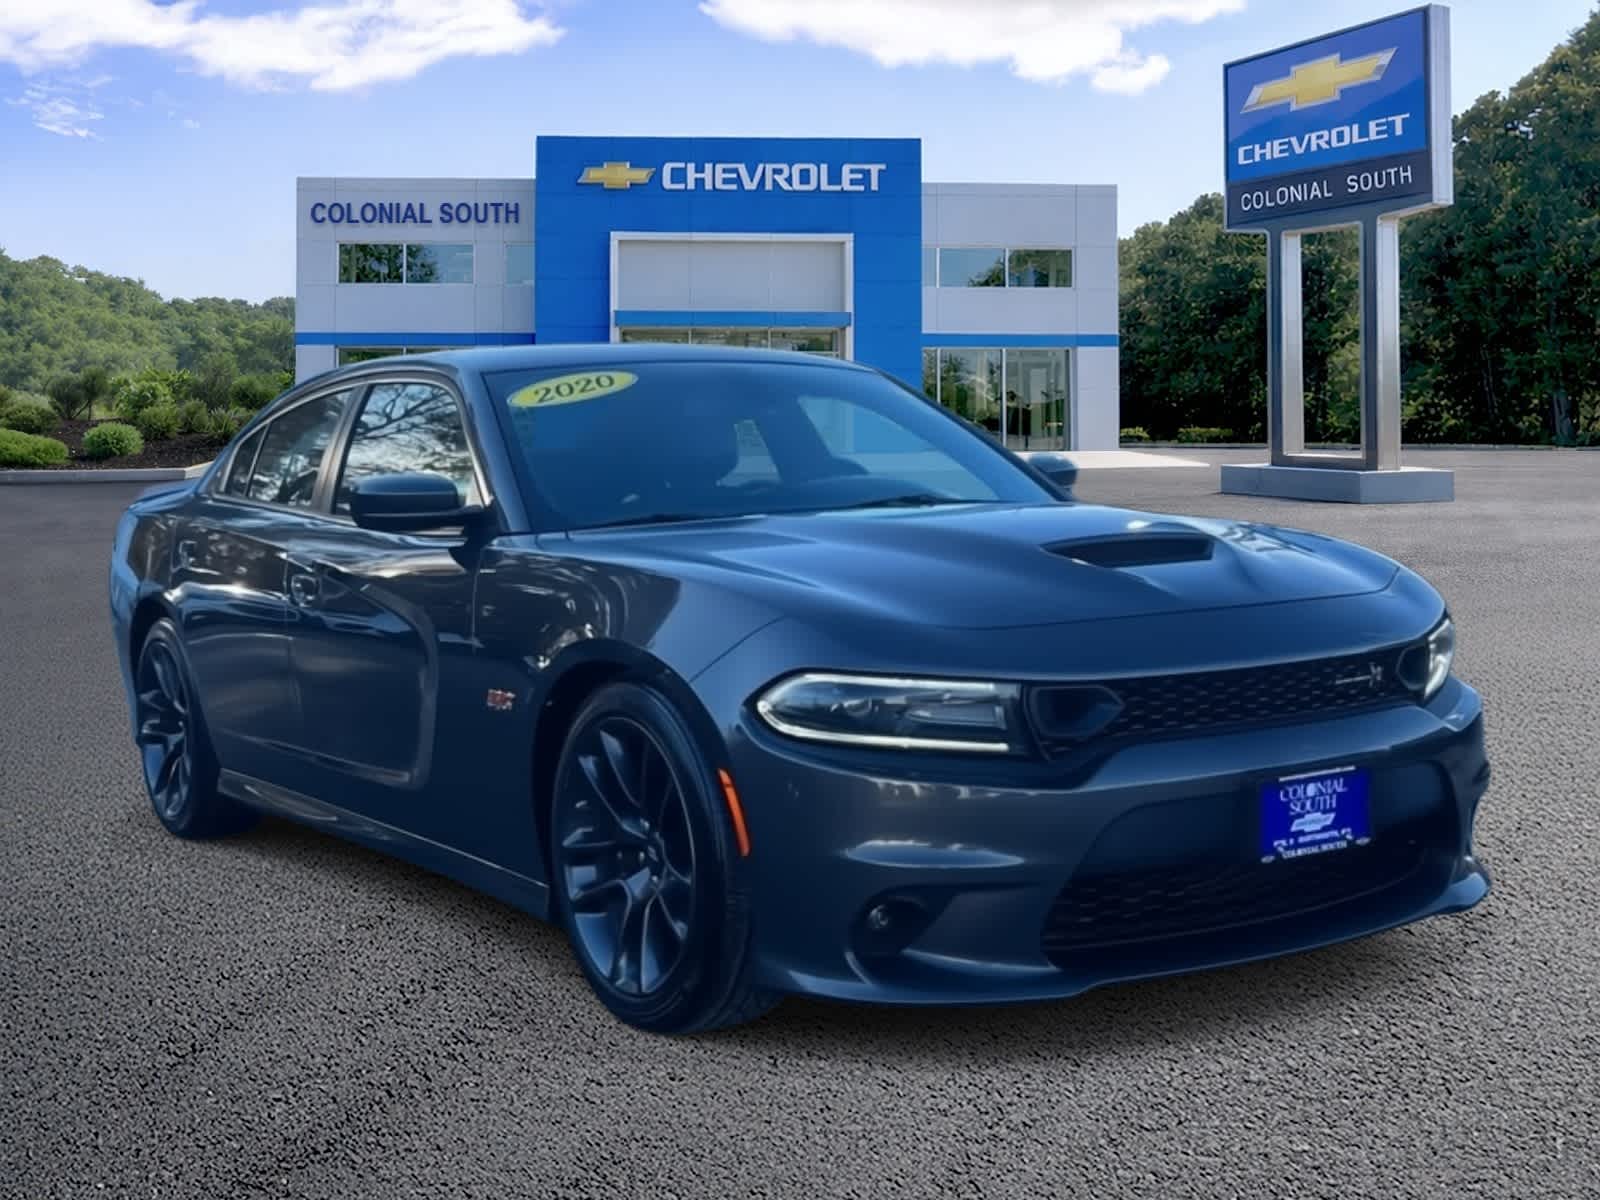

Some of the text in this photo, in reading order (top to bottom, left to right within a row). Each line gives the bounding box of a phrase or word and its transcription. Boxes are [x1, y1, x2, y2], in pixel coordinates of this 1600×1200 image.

[1238, 114, 1410, 165] CHEVROLET
[661, 162, 887, 192] CHEVROLET
[1241, 166, 1412, 211] COLONIAL SOUTH
[310, 202, 520, 224] COLONIAL SOUTH
[534, 375, 615, 404] 2020
